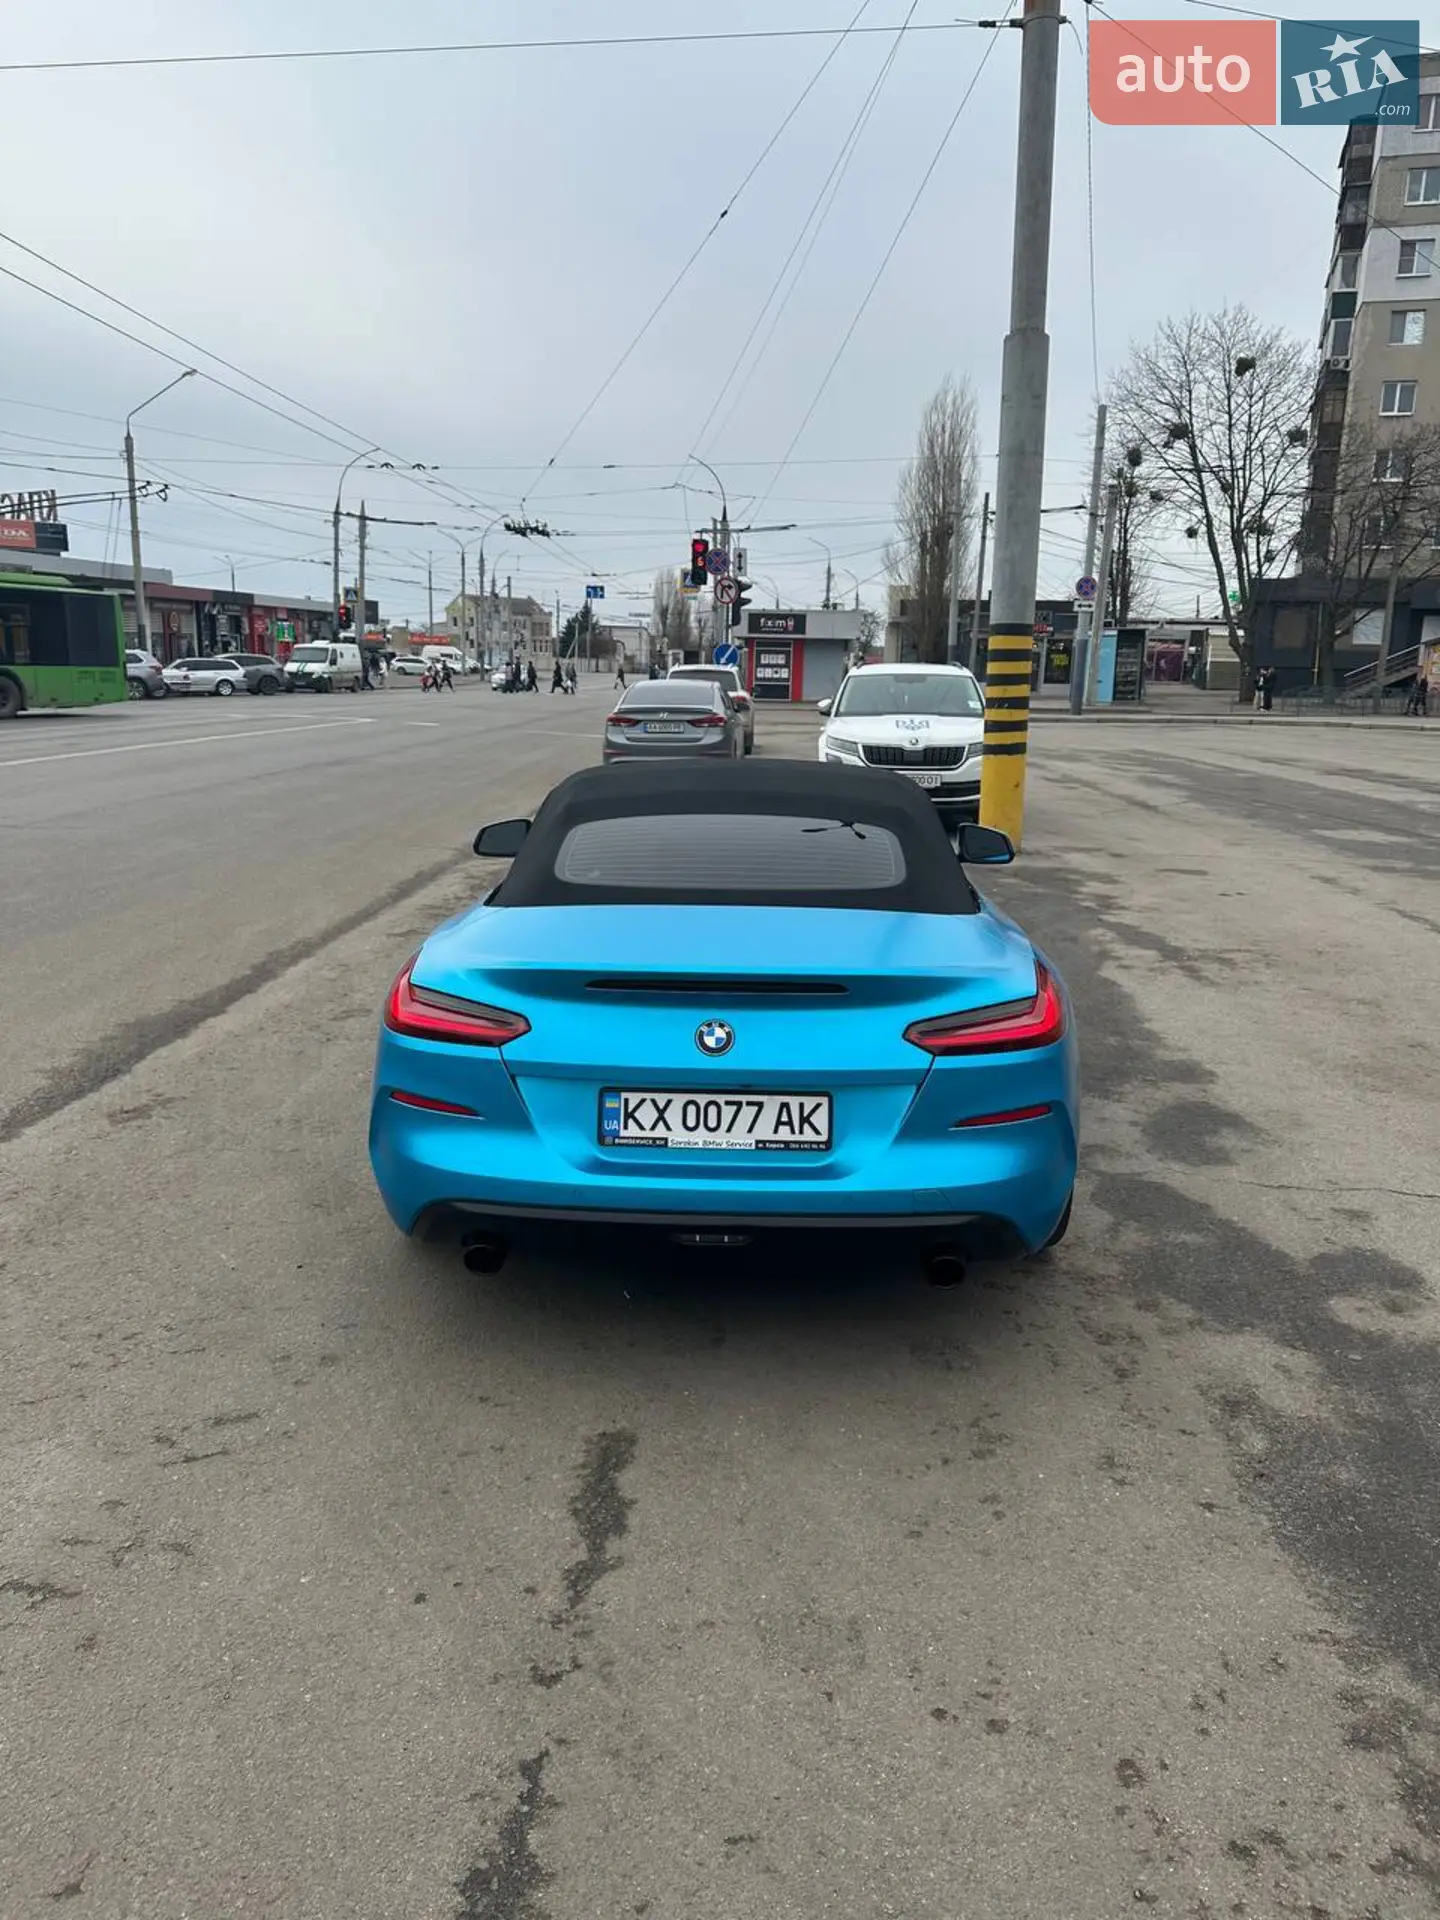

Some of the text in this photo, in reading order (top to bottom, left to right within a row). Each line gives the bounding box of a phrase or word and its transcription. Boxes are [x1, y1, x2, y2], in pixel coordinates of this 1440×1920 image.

[623, 1097, 823, 1136] KX 0077 AK
[603, 1120, 619, 1131] UA
[702, 1140, 723, 1148] BMW
[725, 1140, 753, 1148] Service
